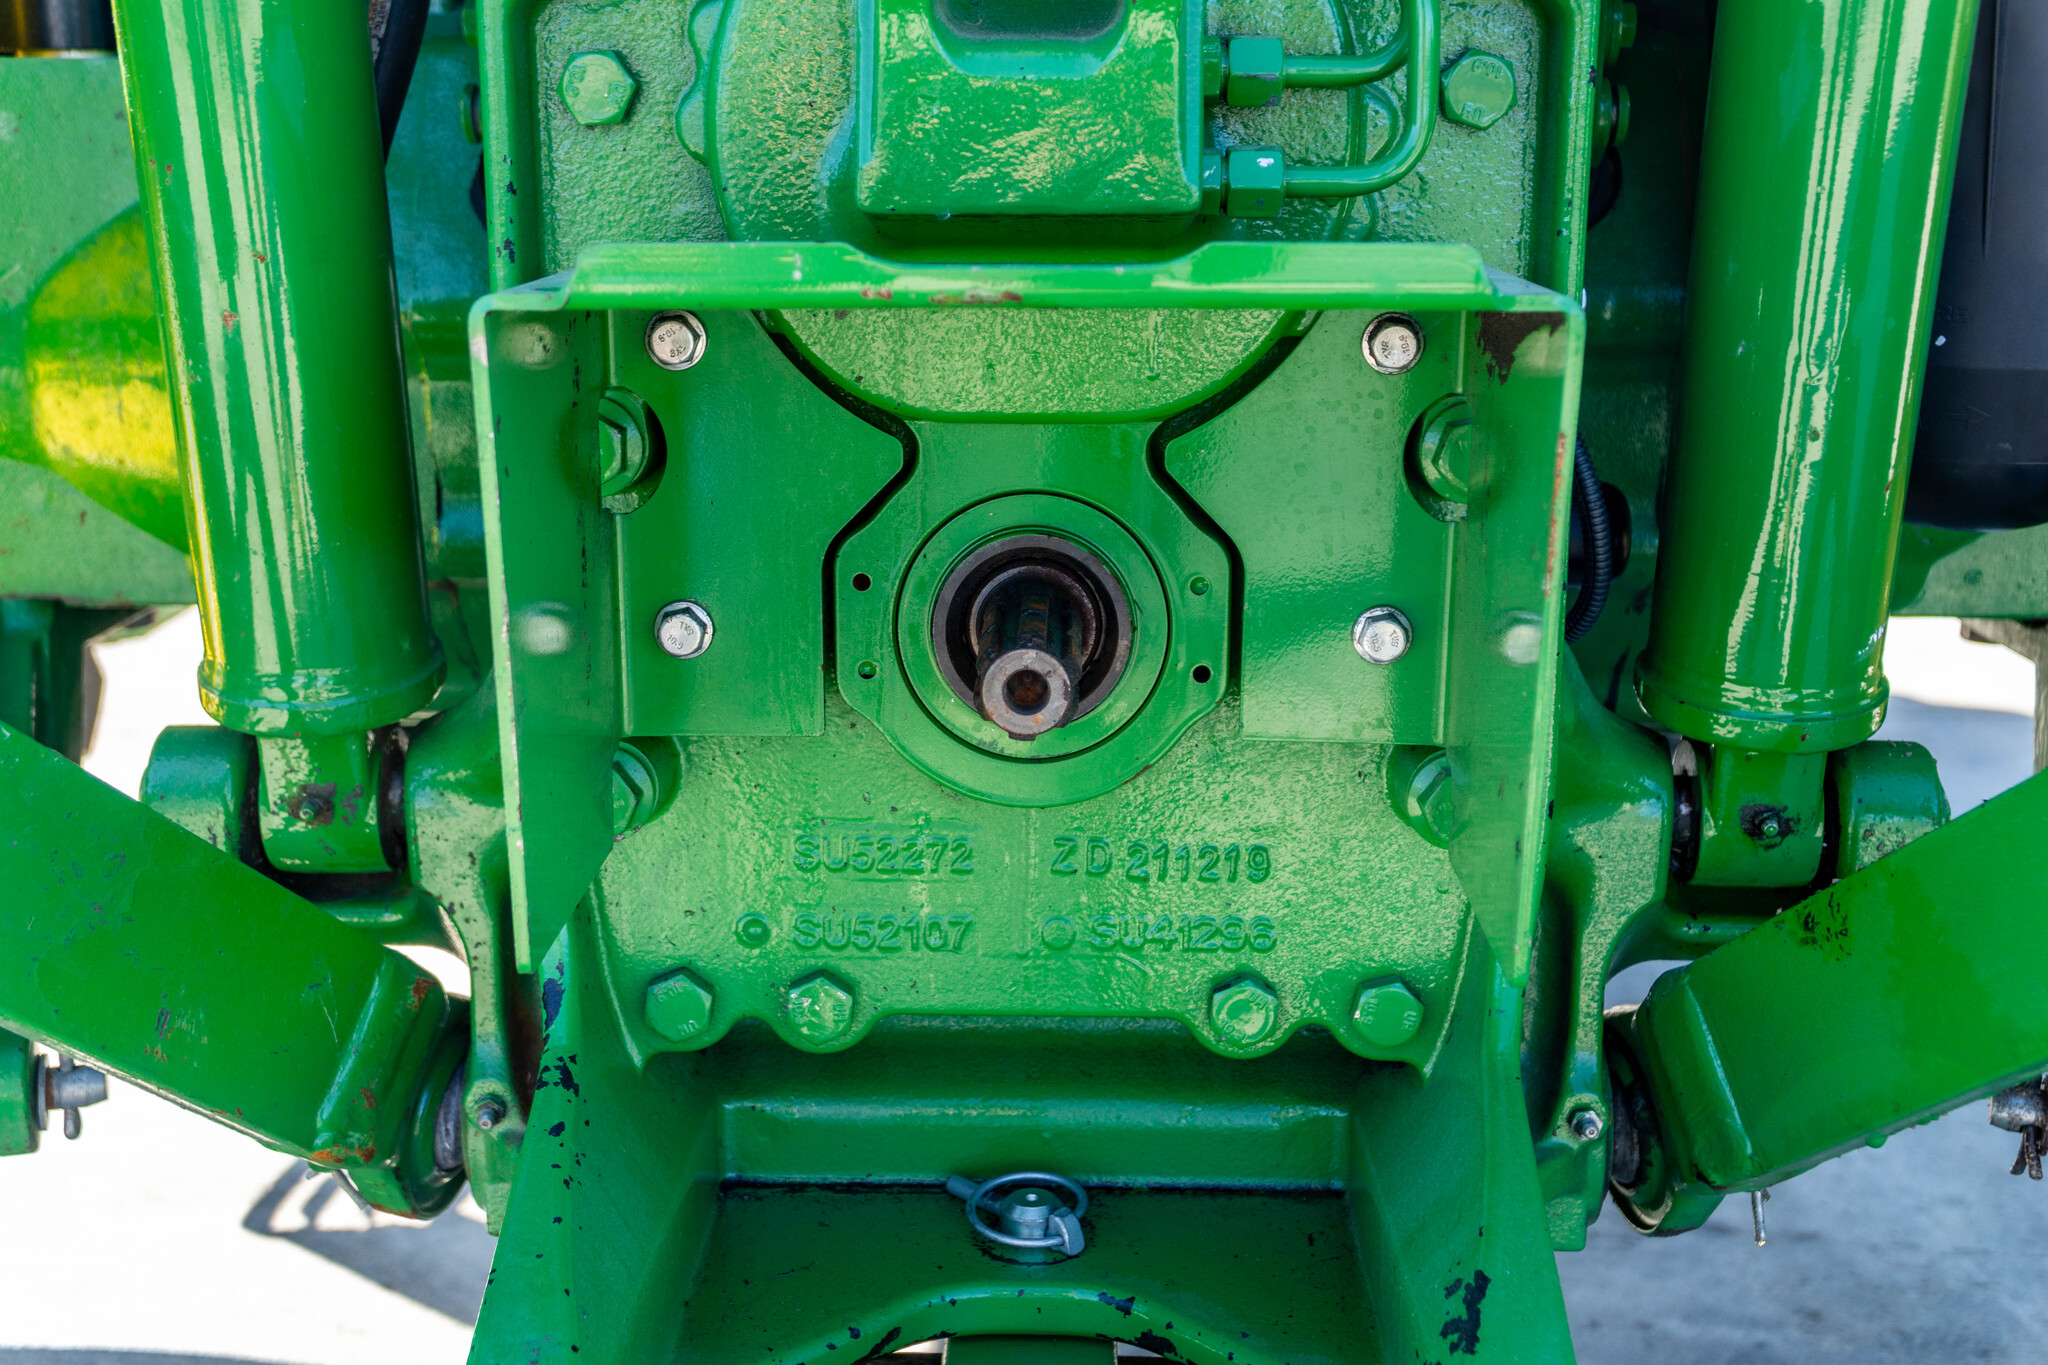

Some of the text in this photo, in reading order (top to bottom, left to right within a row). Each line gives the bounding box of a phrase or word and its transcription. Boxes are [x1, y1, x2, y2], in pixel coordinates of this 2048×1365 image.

[793, 834, 974, 875] SU52272
[1125, 840, 1272, 883] 211219
[793, 912, 973, 953] SU52107
[1089, 914, 1278, 953] SU41296
